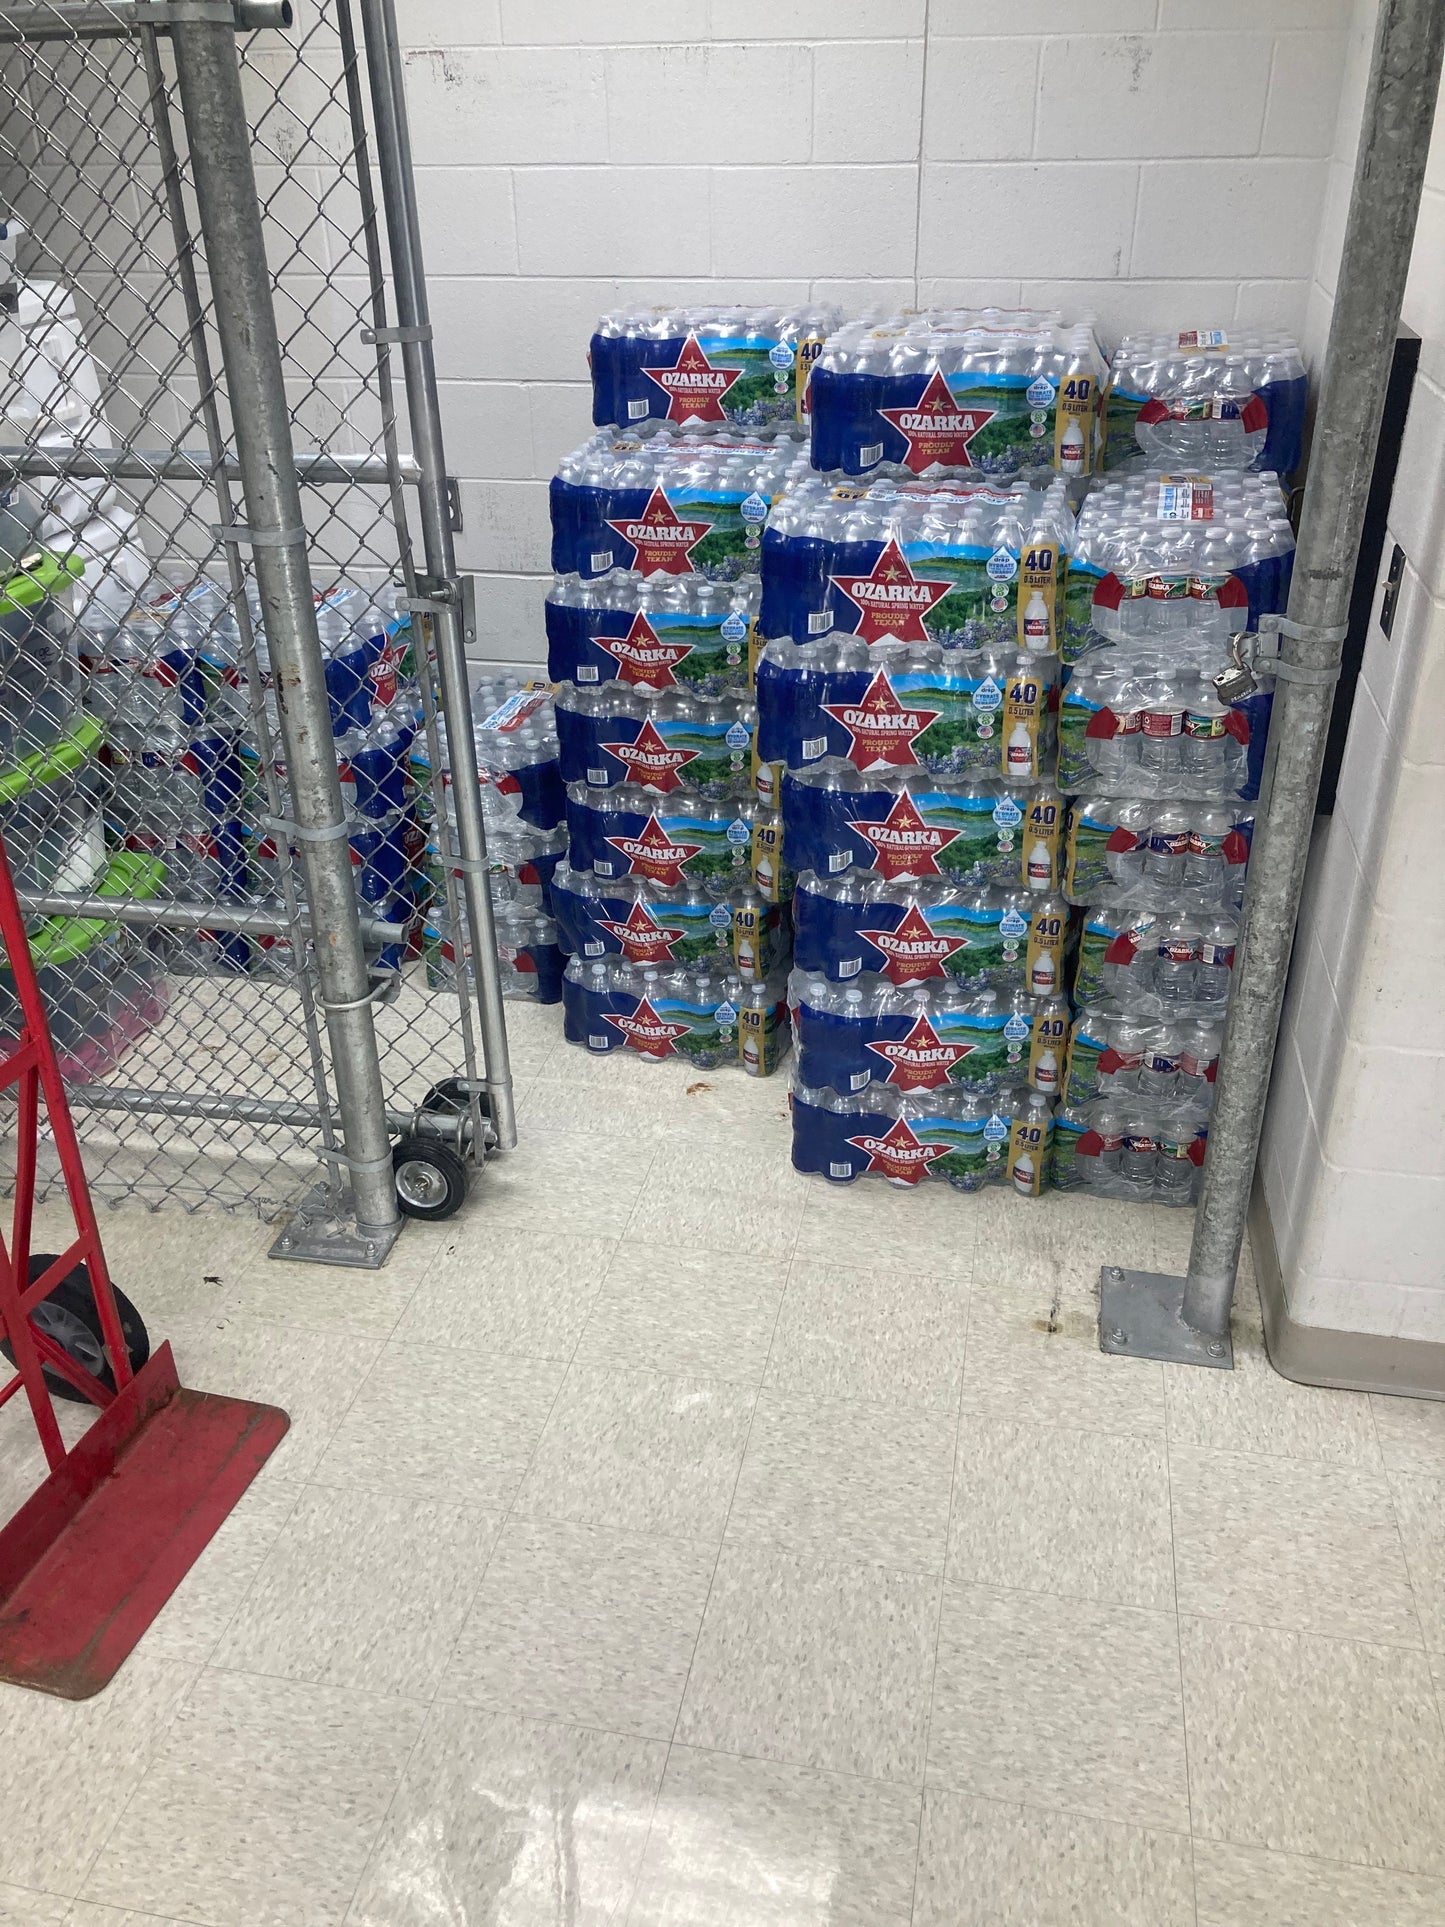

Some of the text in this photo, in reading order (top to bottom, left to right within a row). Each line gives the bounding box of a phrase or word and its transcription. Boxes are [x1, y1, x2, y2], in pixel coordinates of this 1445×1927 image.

[801, 342, 823, 361] 40
[661, 373, 727, 388] OZARKA
[1064, 380, 1090, 400] 40
[1062, 403, 1088, 412] 0.5 LITER
[900, 414, 975, 430] OZARKA
[626, 524, 696, 541] OZARKA
[1024, 550, 1052, 572] 40
[1024, 575, 1050, 584] 0.5 LITER
[852, 582, 932, 602] OZARKA
[871, 612, 910, 620] PROUDLY
[610, 642, 678, 661] OZARKA
[1010, 683, 1037, 704] 40
[843, 710, 920, 730] OZARKA
[1018, 708, 1034, 716] LITER
[618, 747, 684, 766] OZARKA
[1030, 806, 1056, 824] 40
[758, 829, 776, 844] 40
[868, 826, 942, 846] OZARKA
[623, 842, 686, 860] OZARKA
[735, 912, 754, 928] 40
[1036, 918, 1061, 936] 40
[613, 926, 672, 942] OZARKA
[878, 936, 950, 954] OZARKA
[618, 1018, 676, 1036] OZARKA
[742, 1012, 760, 1026] 40
[1038, 1020, 1064, 1036] 40
[885, 1045, 956, 1062] OZARKA
[1017, 1126, 1042, 1142] 40
[864, 1139, 936, 1159] OZARKA
